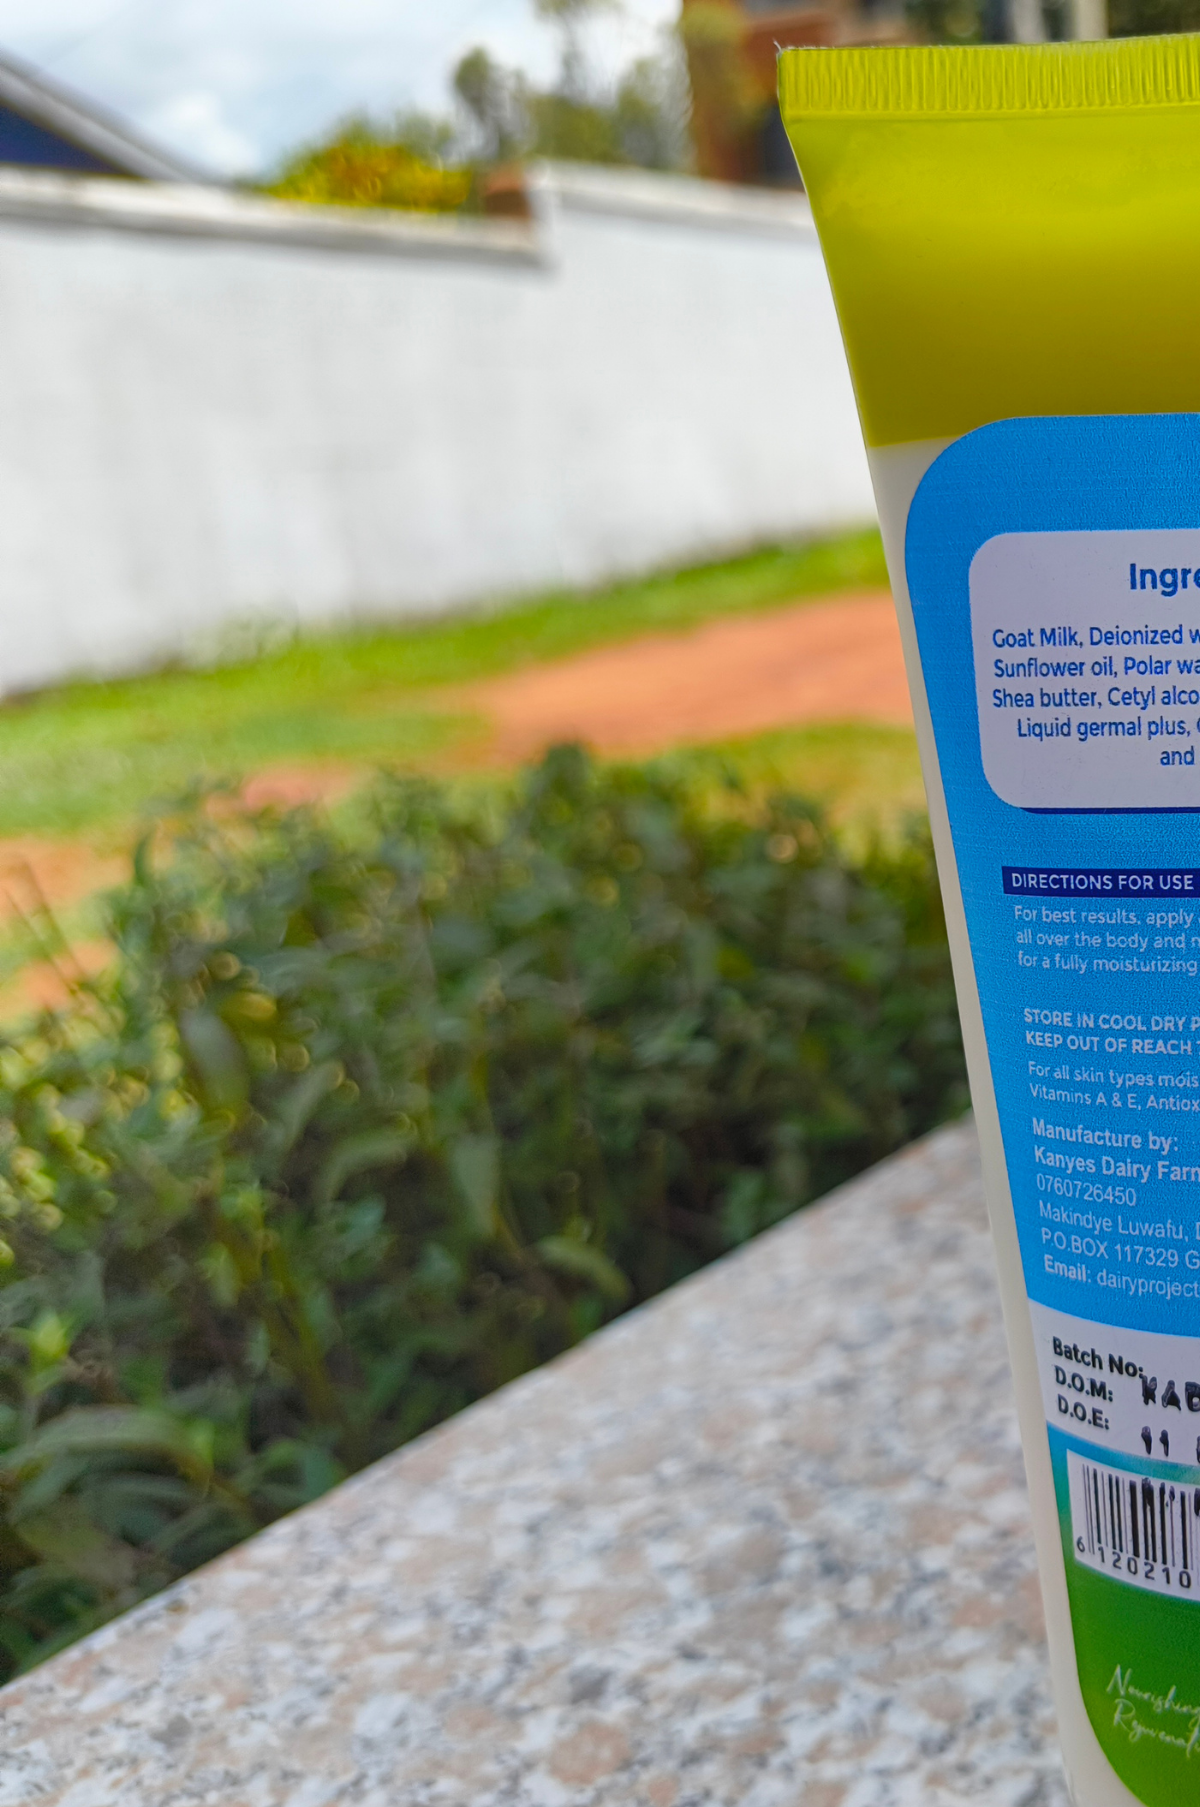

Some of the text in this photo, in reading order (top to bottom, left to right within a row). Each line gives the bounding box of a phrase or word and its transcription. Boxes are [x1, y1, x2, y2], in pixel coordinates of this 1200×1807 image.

[992, 628, 1035, 648] Goat
[1040, 627, 1083, 648] Milk,
[1089, 624, 1183, 646] Deionized
[994, 657, 1085, 678] Sunflower
[1091, 656, 1118, 677] oil,
[1124, 655, 1171, 676] Polar
[992, 688, 1034, 708] Shea
[1040, 688, 1102, 709] butter,
[1107, 686, 1156, 710] Cetyl
[1018, 718, 1071, 741] Liquid
[1077, 716, 1141, 742] germal
[1148, 716, 1191, 740] plus,
[1160, 746, 1195, 766] and
[1011, 873, 1195, 890] DIRECTIONS FOR USE
[1014, 905, 1037, 921] For
[1042, 906, 1076, 923] best
[1146, 910, 1194, 928] apply
[1016, 929, 1032, 944] all
[1036, 934, 1070, 946] over
[1075, 933, 1101, 948] the
[1106, 932, 1148, 952] body
[1153, 933, 1185, 948] and
[1018, 950, 1037, 967] for
[1042, 956, 1050, 968] a
[1054, 953, 1088, 974] fully
[1093, 956, 1197, 976] moisturizing
[1023, 1007, 1072, 1028] STORE
[1077, 1012, 1094, 1028] IN
[1098, 1014, 1147, 1032] COOL
[1151, 1016, 1186, 1032] DRY
[1025, 1030, 1063, 1048] KEEP
[1067, 1035, 1099, 1052] OUT
[1104, 1037, 1127, 1053] OF
[1131, 1039, 1192, 1055] REACH
[1028, 1060, 1050, 1078] For
[1053, 1064, 1069, 1080] all
[1073, 1066, 1104, 1083] skin
[1108, 1069, 1154, 1089] types
[1029, 1082, 1092, 1105] Vitamins
[1096, 1092, 1107, 1106] A
[1111, 1092, 1122, 1107] &
[1032, 1117, 1179, 1155] Manufacture by:
[1034, 1145, 1096, 1174] Kanyes
[1101, 1156, 1151, 1183] Dairy
[1036, 1173, 1137, 1207] 0760726450
[1039, 1199, 1113, 1235] Makindye
[1118, 1215, 1188, 1242] Luwafu,
[1044, 1254, 1091, 1283] Email:
[1114, 1244, 1179, 1268] 117329
[1052, 1335, 1144, 1379] Batch No:
[1054, 1364, 1113, 1402] D.O.M:
[1057, 1393, 1109, 1430] D.O.E:
[1076, 1536, 1086, 1553] 6
[1098, 1546, 1192, 1590] 120210
